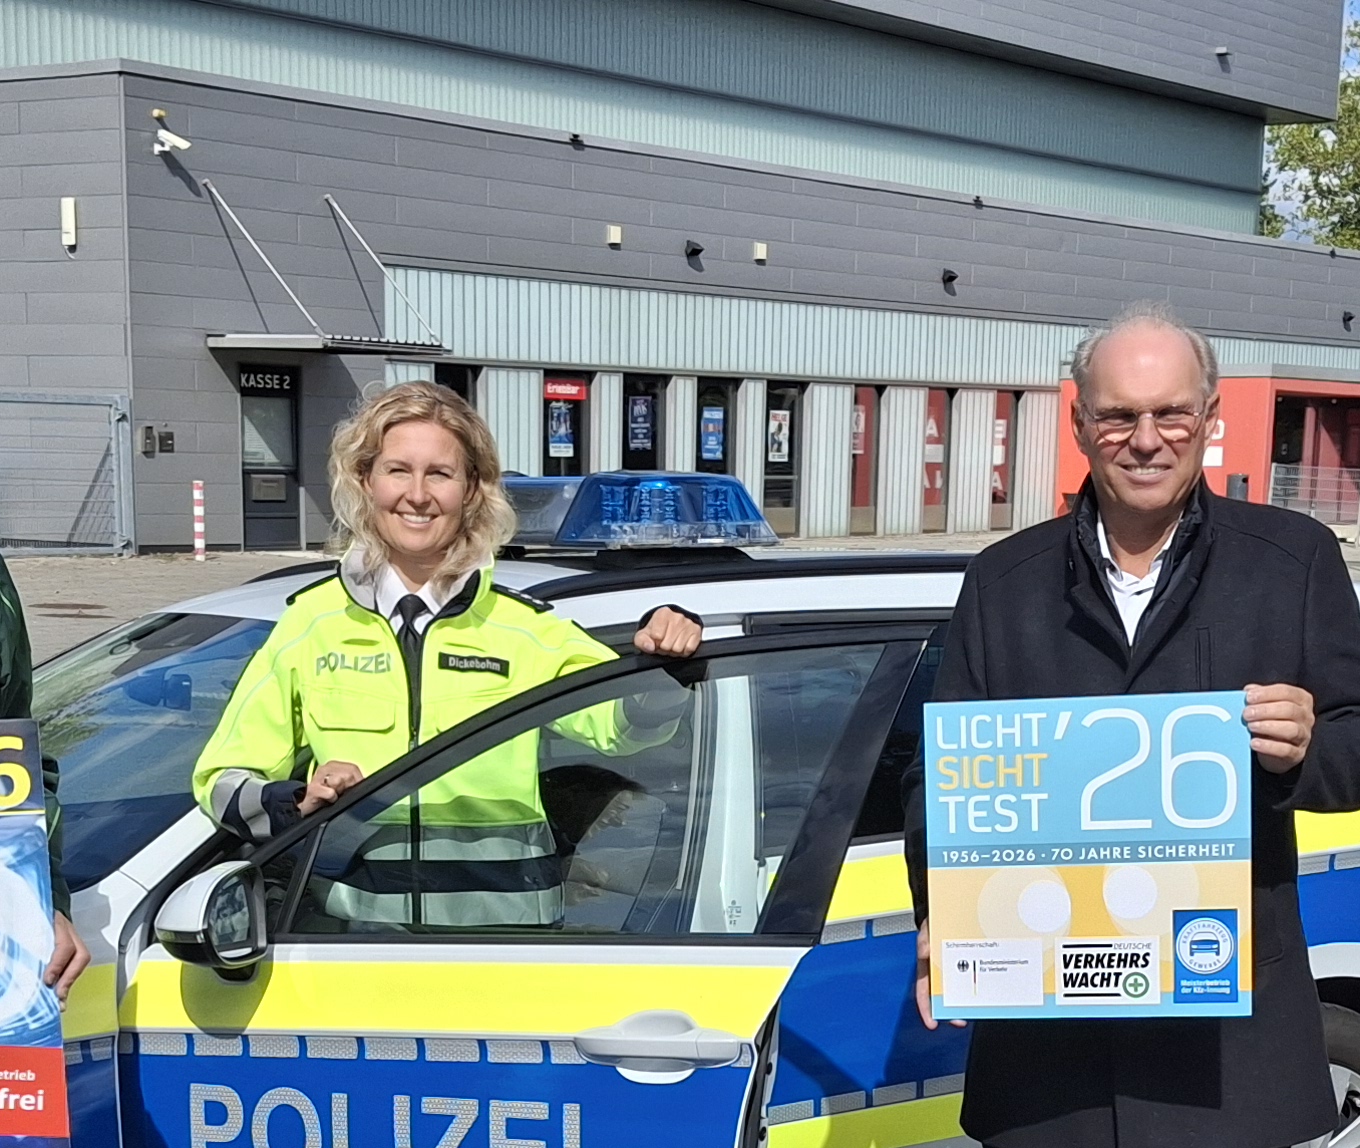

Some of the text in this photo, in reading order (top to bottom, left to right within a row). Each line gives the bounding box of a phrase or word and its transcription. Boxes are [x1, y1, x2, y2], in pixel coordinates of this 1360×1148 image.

[240, 373, 291, 389] KASSE 2
[316, 652, 391, 676] POLIZEI
[935, 711, 1048, 750] LICHT
[937, 753, 1049, 790] SICHT
[938, 793, 1049, 834] TEST
[1051, 848, 1073, 861] 70
[1079, 845, 1132, 861] JAHRE
[1137, 843, 1236, 859] SICHERHEIT
[1062, 952, 1151, 970] VERKEHRS
[1063, 972, 1123, 988] WACHT
